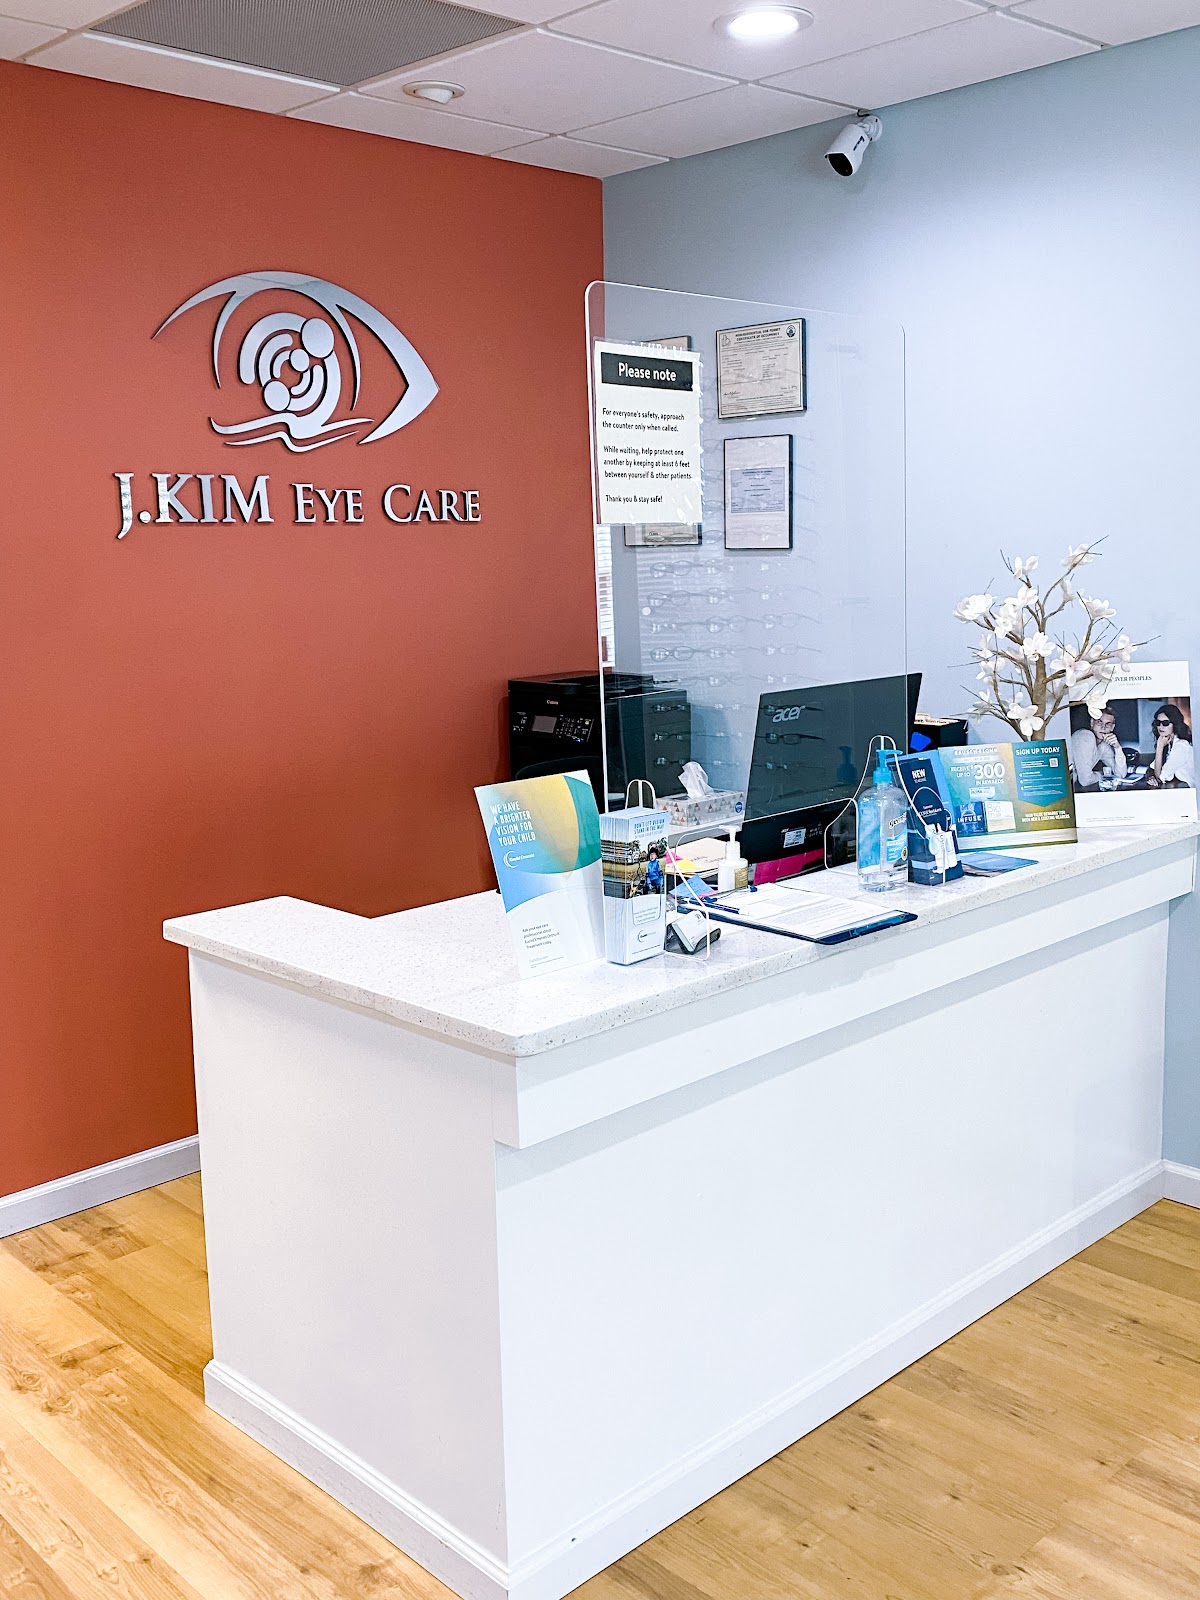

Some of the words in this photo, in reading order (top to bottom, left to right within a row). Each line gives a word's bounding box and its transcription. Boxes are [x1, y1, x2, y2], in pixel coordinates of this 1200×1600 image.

[618, 362, 650, 379] Please
[653, 369, 677, 382] note
[602, 408, 612, 416] For
[612, 410, 641, 419] everyone's
[642, 410, 660, 420] safety,
[660, 413, 685, 422] approach
[602, 420, 612, 428] the
[634, 423, 646, 432] only
[646, 423, 661, 431] when
[604, 445, 619, 453] While
[620, 446, 640, 456] waiting,
[641, 447, 653, 456] help
[604, 458, 625, 466] another
[625, 458, 632, 468] by
[633, 459, 654, 468] keeping
[604, 470, 628, 478] between
[628, 470, 650, 480] yourself
[650, 471, 654, 479] &
[605, 494, 622, 502] Thank
[622, 496, 632, 504] you
[638, 496, 650, 504] stay
[114, 473, 275, 540] J.KIM
[772, 705, 806, 723] acer
[912, 768, 926, 779] NEW
[490, 804, 502, 814] WE
[502, 801, 520, 812] HAVE
[494, 816, 499, 825] A
[500, 810, 532, 824] BRIGHTER
[495, 823, 519, 835] VISION
[520, 821, 533, 832] FOR
[498, 836, 517, 846] YOUR
[518, 832, 536, 843] CHILD
